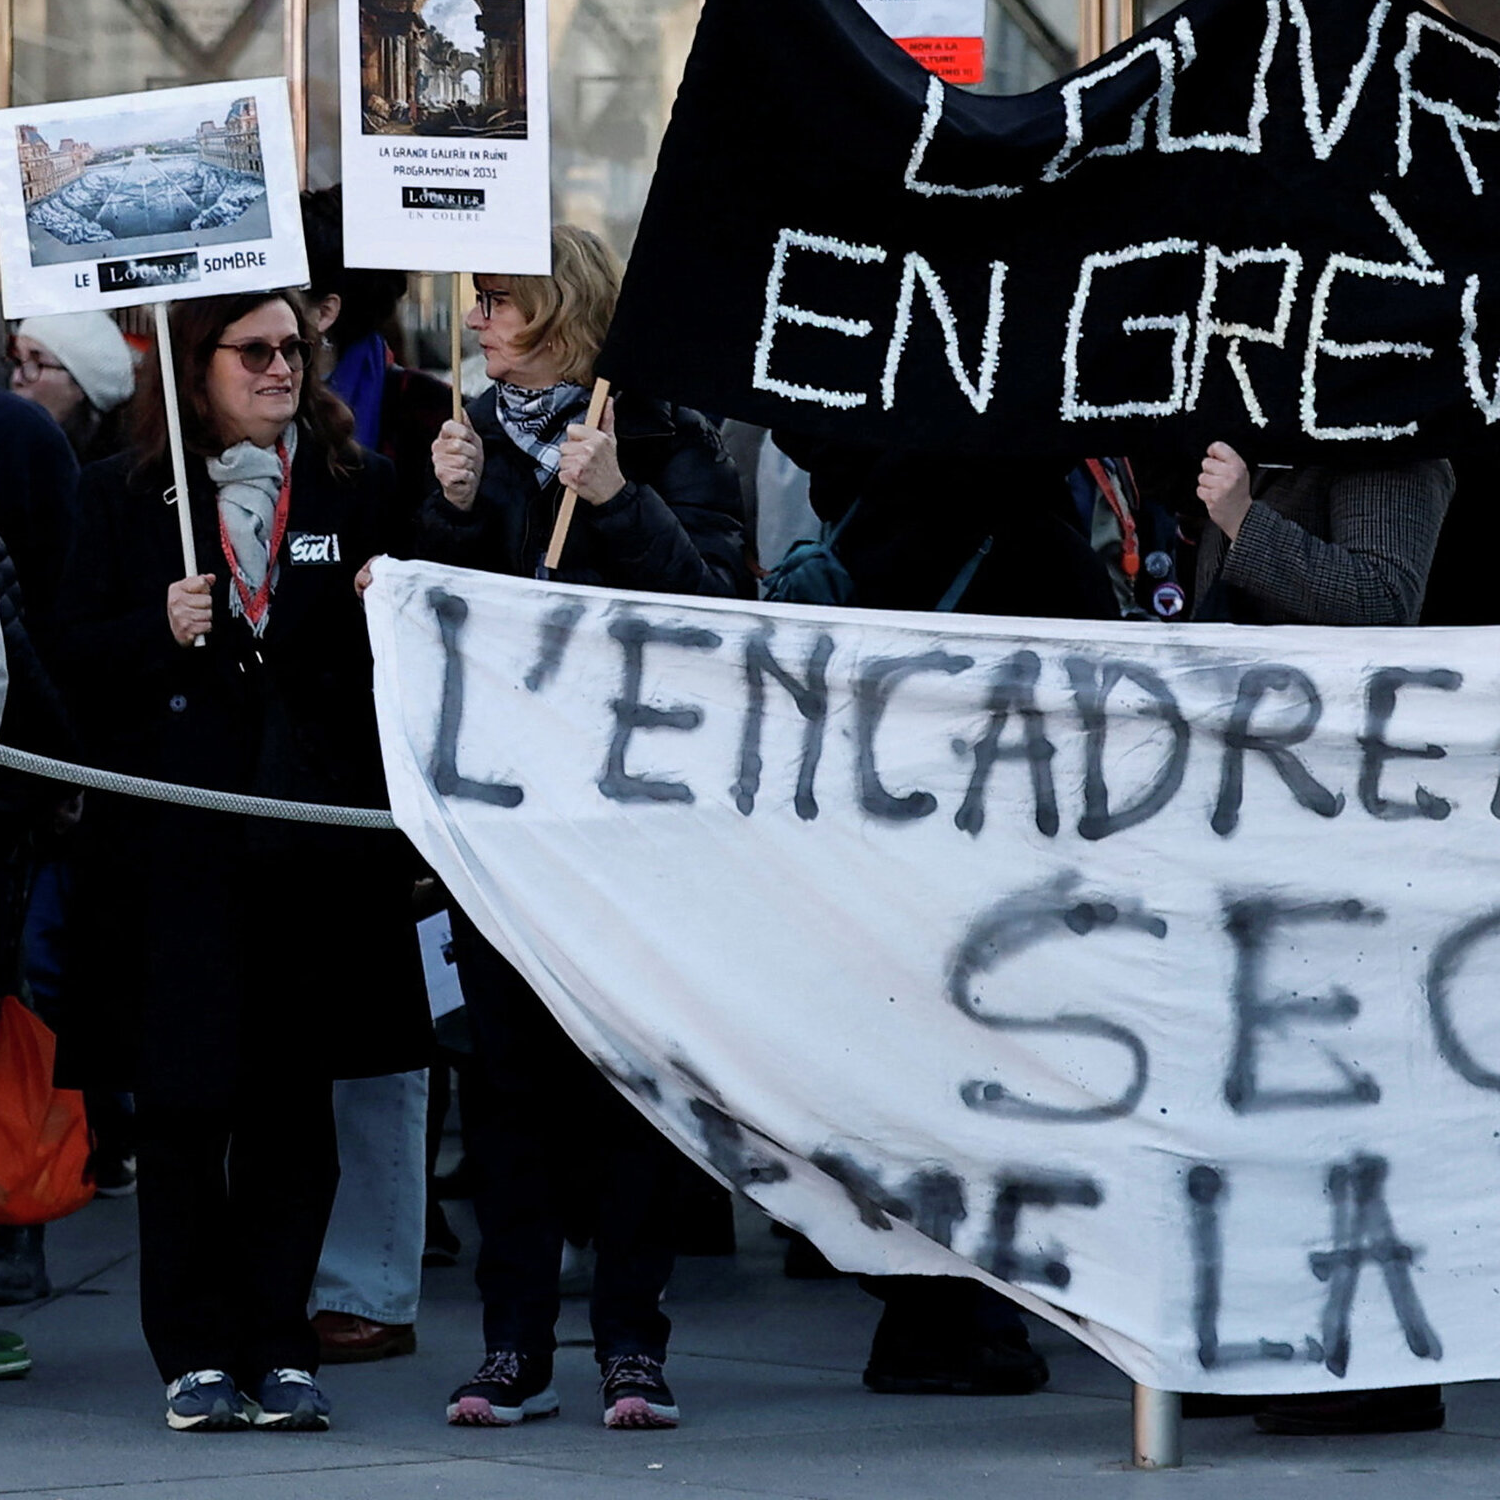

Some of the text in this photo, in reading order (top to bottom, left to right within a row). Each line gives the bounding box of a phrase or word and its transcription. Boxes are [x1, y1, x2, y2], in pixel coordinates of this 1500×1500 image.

[379, 148, 390, 157] LA
[393, 148, 428, 158] GRANDE
[469, 151, 480, 160] EN
[473, 167, 497, 179] 2031
[408, 211, 424, 220] EN
[75, 252, 266, 288] LE LOUVRE SOMBRE
[753, 228, 1007, 414] EN
[425, 585, 1500, 840] L'ENCADRE
[1186, 1151, 1443, 1380] LA
